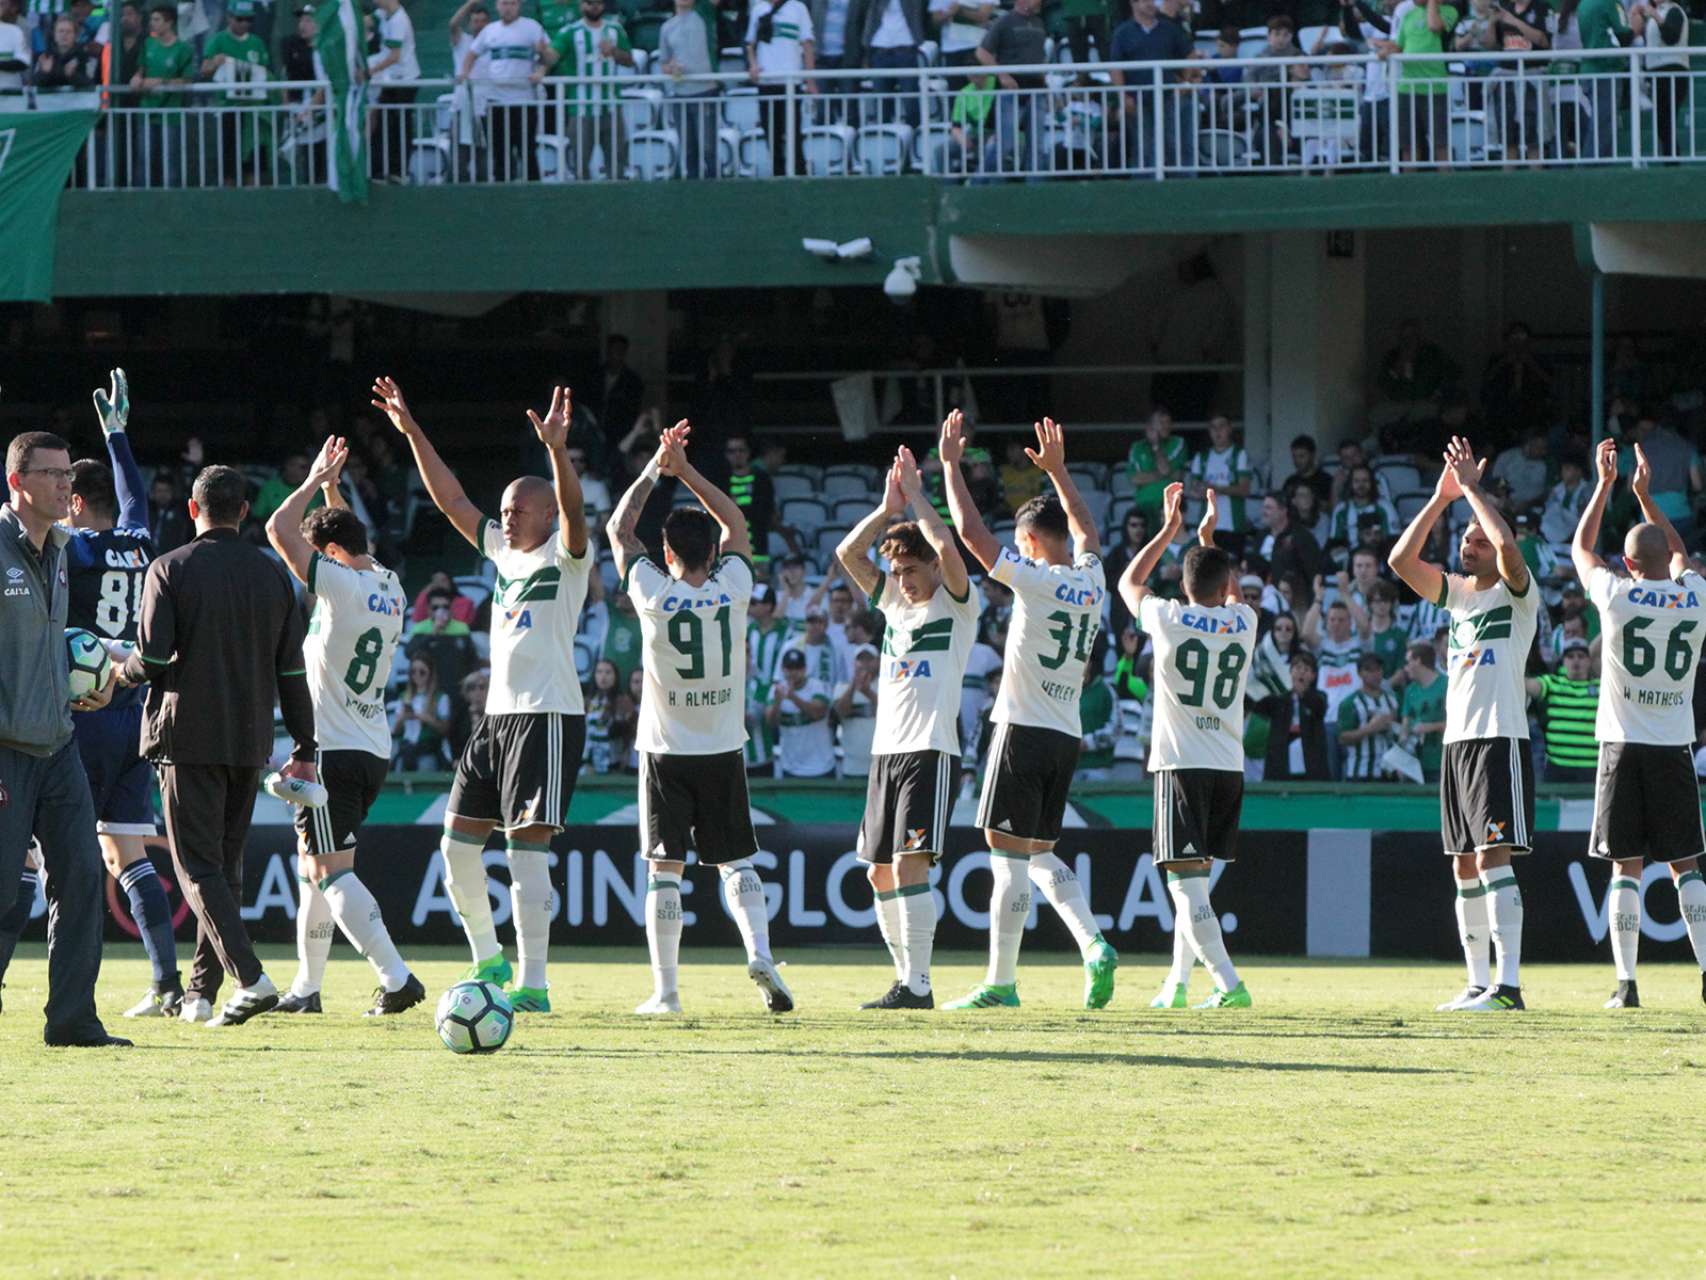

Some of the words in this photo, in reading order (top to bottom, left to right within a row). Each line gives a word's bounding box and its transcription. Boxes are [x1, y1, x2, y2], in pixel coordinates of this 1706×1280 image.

[1628, 587, 1700, 609] CAIXA
[668, 605, 732, 680] 91
[1181, 612, 1248, 636] CAIXA
[1623, 615, 1699, 682] 66
[1175, 637, 1247, 710] 98
[1638, 689, 1684, 706] MATHEUS
